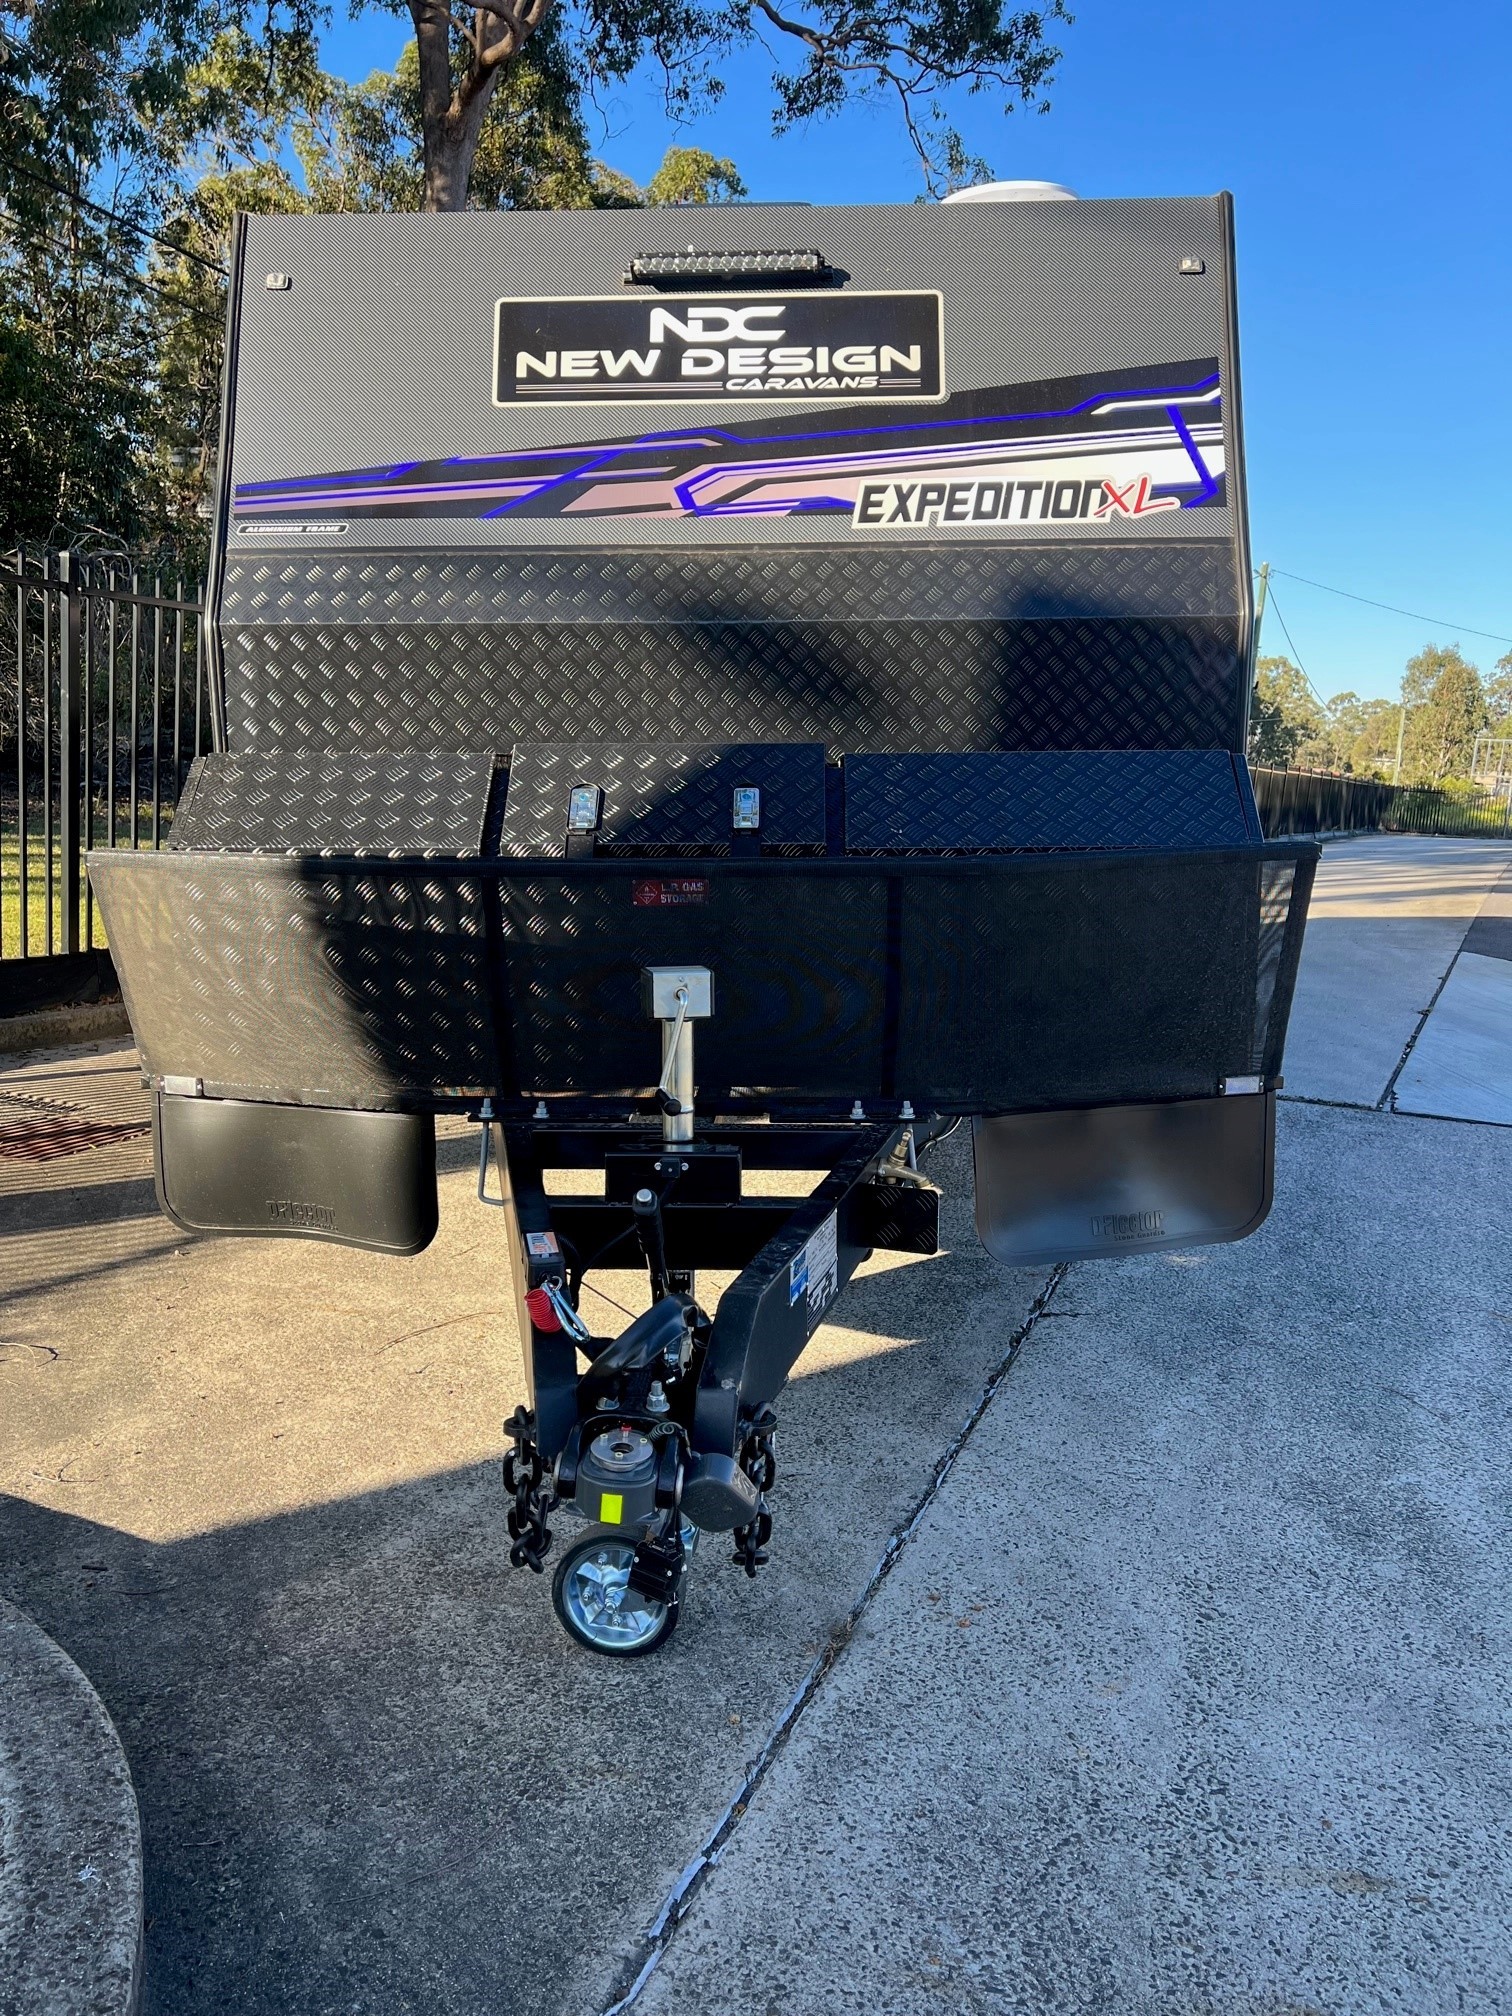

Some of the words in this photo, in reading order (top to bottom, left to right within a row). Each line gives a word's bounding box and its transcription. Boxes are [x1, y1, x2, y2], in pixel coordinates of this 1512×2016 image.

[649, 305, 787, 343] NDC
[515, 349, 661, 379] NEW
[681, 344, 921, 375] DESIGN
[725, 375, 880, 391] CARAVANS
[857, 480, 1108, 523] EXPEDITION
[1093, 476, 1179, 518] XL
[245, 525, 303, 533] ALUMINIUM
